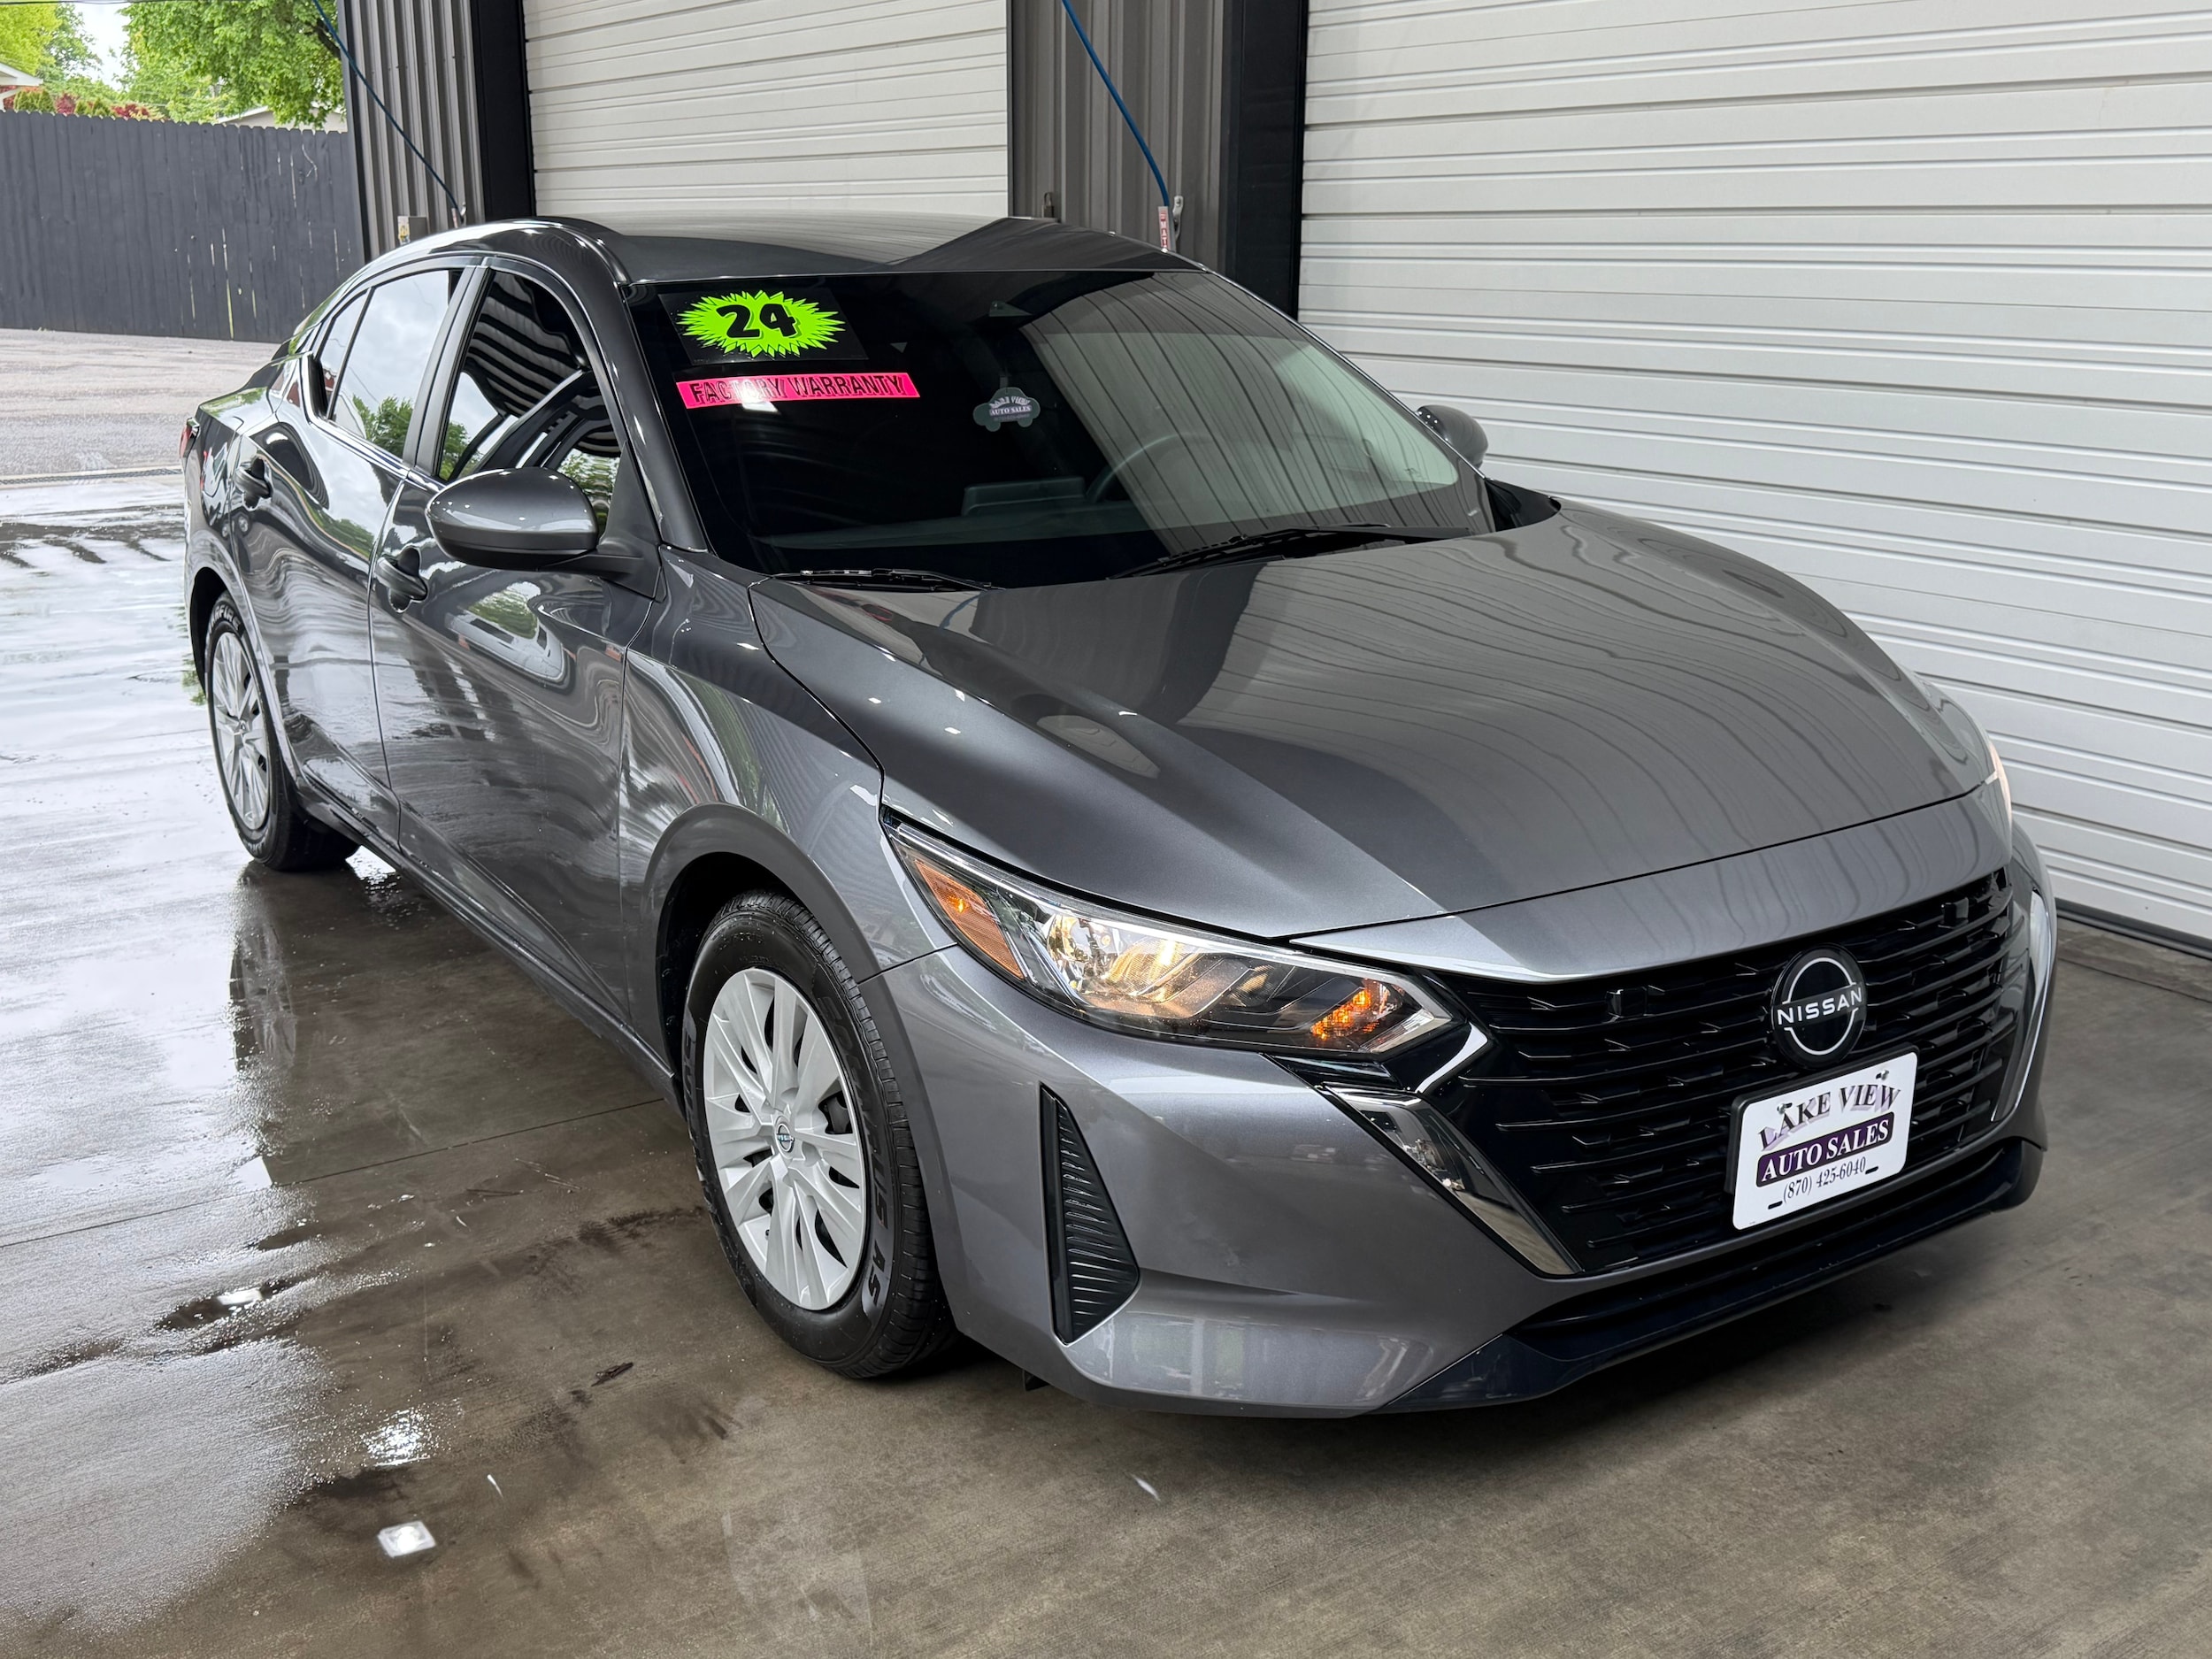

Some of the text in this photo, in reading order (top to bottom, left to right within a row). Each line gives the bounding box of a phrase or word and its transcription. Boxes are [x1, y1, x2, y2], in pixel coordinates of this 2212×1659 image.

[716, 303, 796, 338] 24
[787, 374, 902, 397] WARRANTY
[1777, 987, 1863, 1025] NISSAN
[1758, 1084, 1901, 1151] LAKE VIEW
[1761, 1118, 1890, 1182] AUTO SALES
[1782, 1156, 1867, 1204] (870) 425-6040
